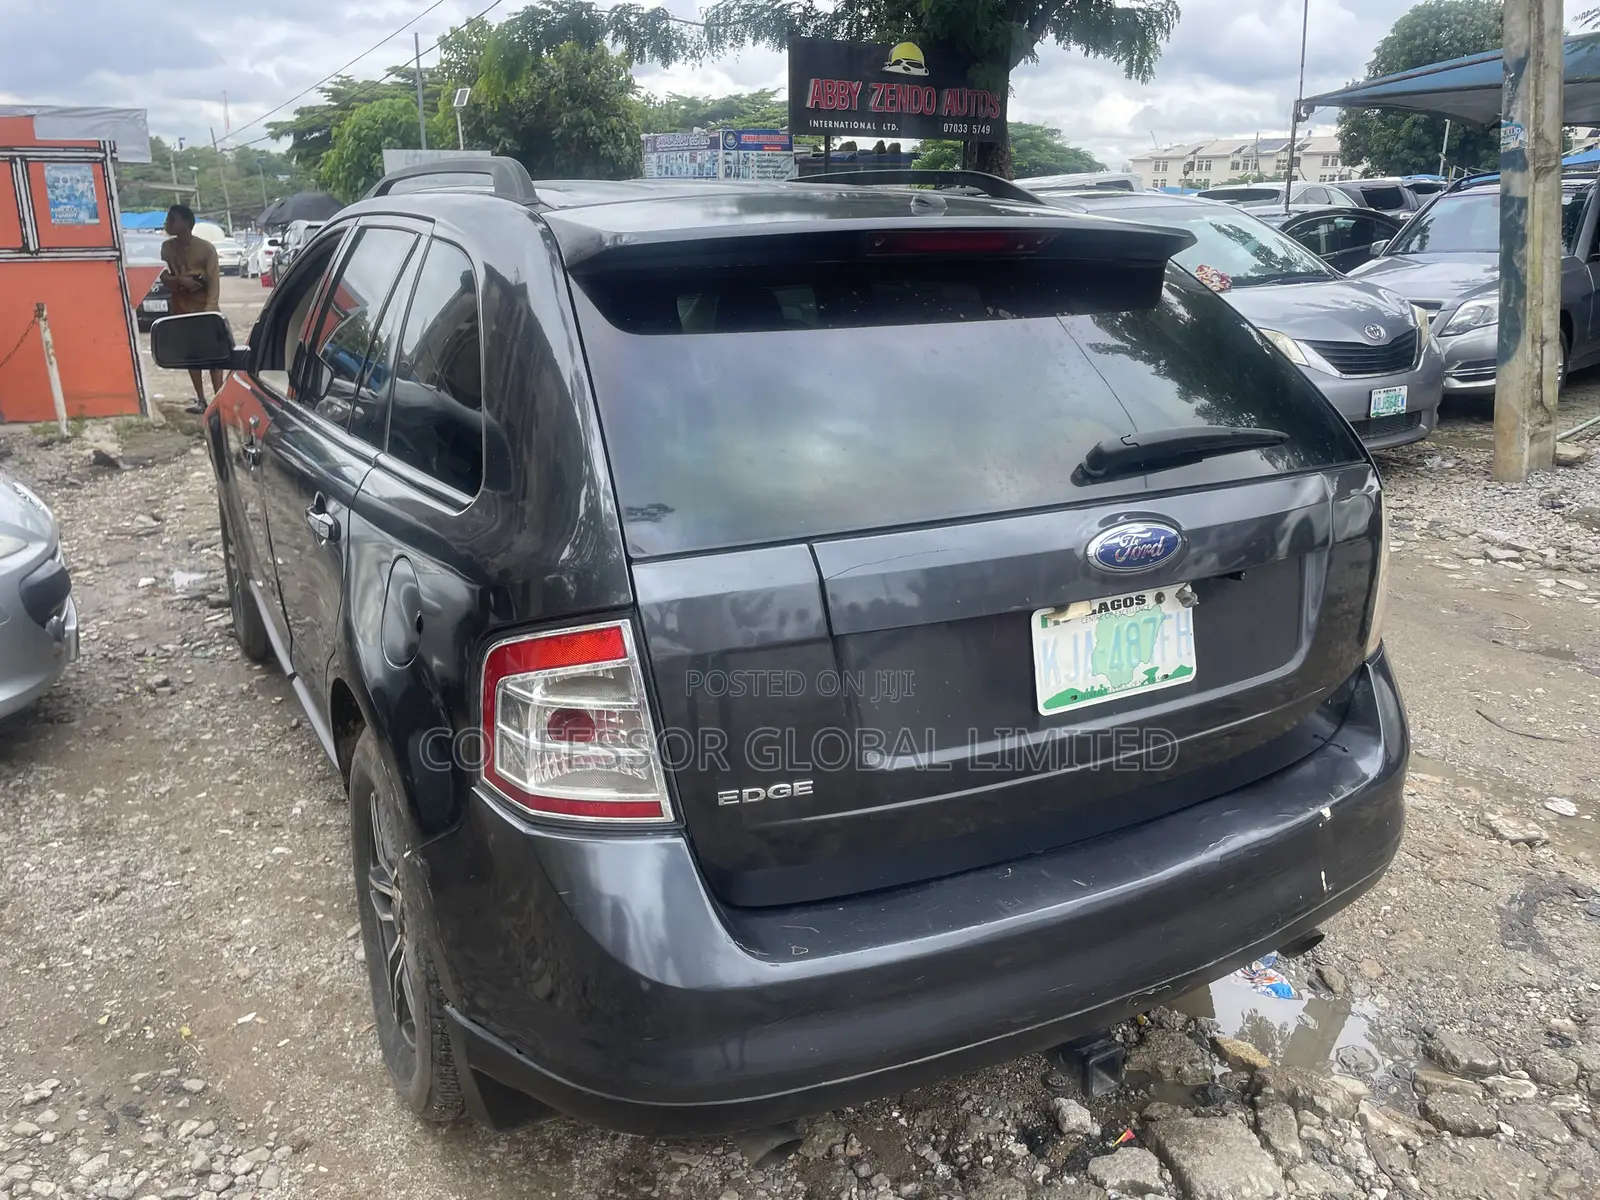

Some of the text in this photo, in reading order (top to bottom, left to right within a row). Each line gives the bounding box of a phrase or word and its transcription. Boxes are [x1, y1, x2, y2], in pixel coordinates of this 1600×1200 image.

[806, 78, 1001, 119] ABBY ZENDO AUTOS
[809, 119, 899, 131] INTERNATIONAL LTD.
[943, 122, 991, 134] 07033 5749
[1115, 531, 1165, 562] Ford
[717, 780, 814, 806] EDGE
